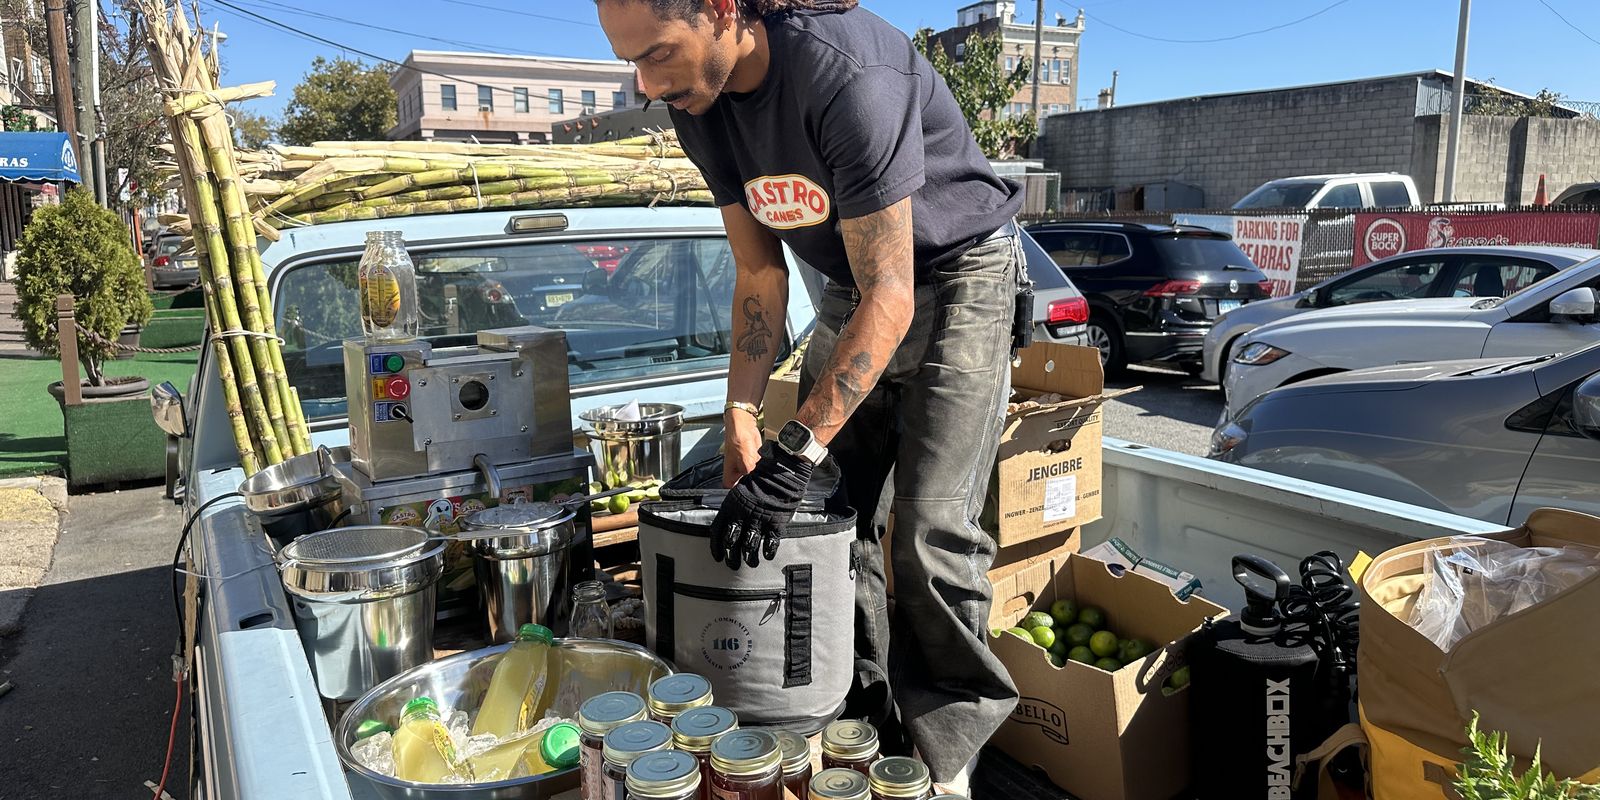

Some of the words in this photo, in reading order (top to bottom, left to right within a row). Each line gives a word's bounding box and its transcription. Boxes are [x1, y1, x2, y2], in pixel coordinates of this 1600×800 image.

[0, 157, 28, 168] RAS
[747, 181, 825, 215] CASTRO
[766, 208, 804, 223] CANES
[1237, 220, 1277, 241] PARKING
[1280, 222, 1300, 242] FOR
[1371, 232, 1399, 242] SUPER
[1371, 241, 1397, 251] BOCK
[1026, 457, 1082, 483] JENGIBRE
[1004, 509, 1026, 519] INGWER
[1029, 504, 1045, 514] ZENZE
[714, 617, 750, 636] COMMUNITY
[713, 637, 740, 651] 116
[1014, 702, 1061, 727] BELLO
[1266, 678, 1291, 800] BEACHBOX
